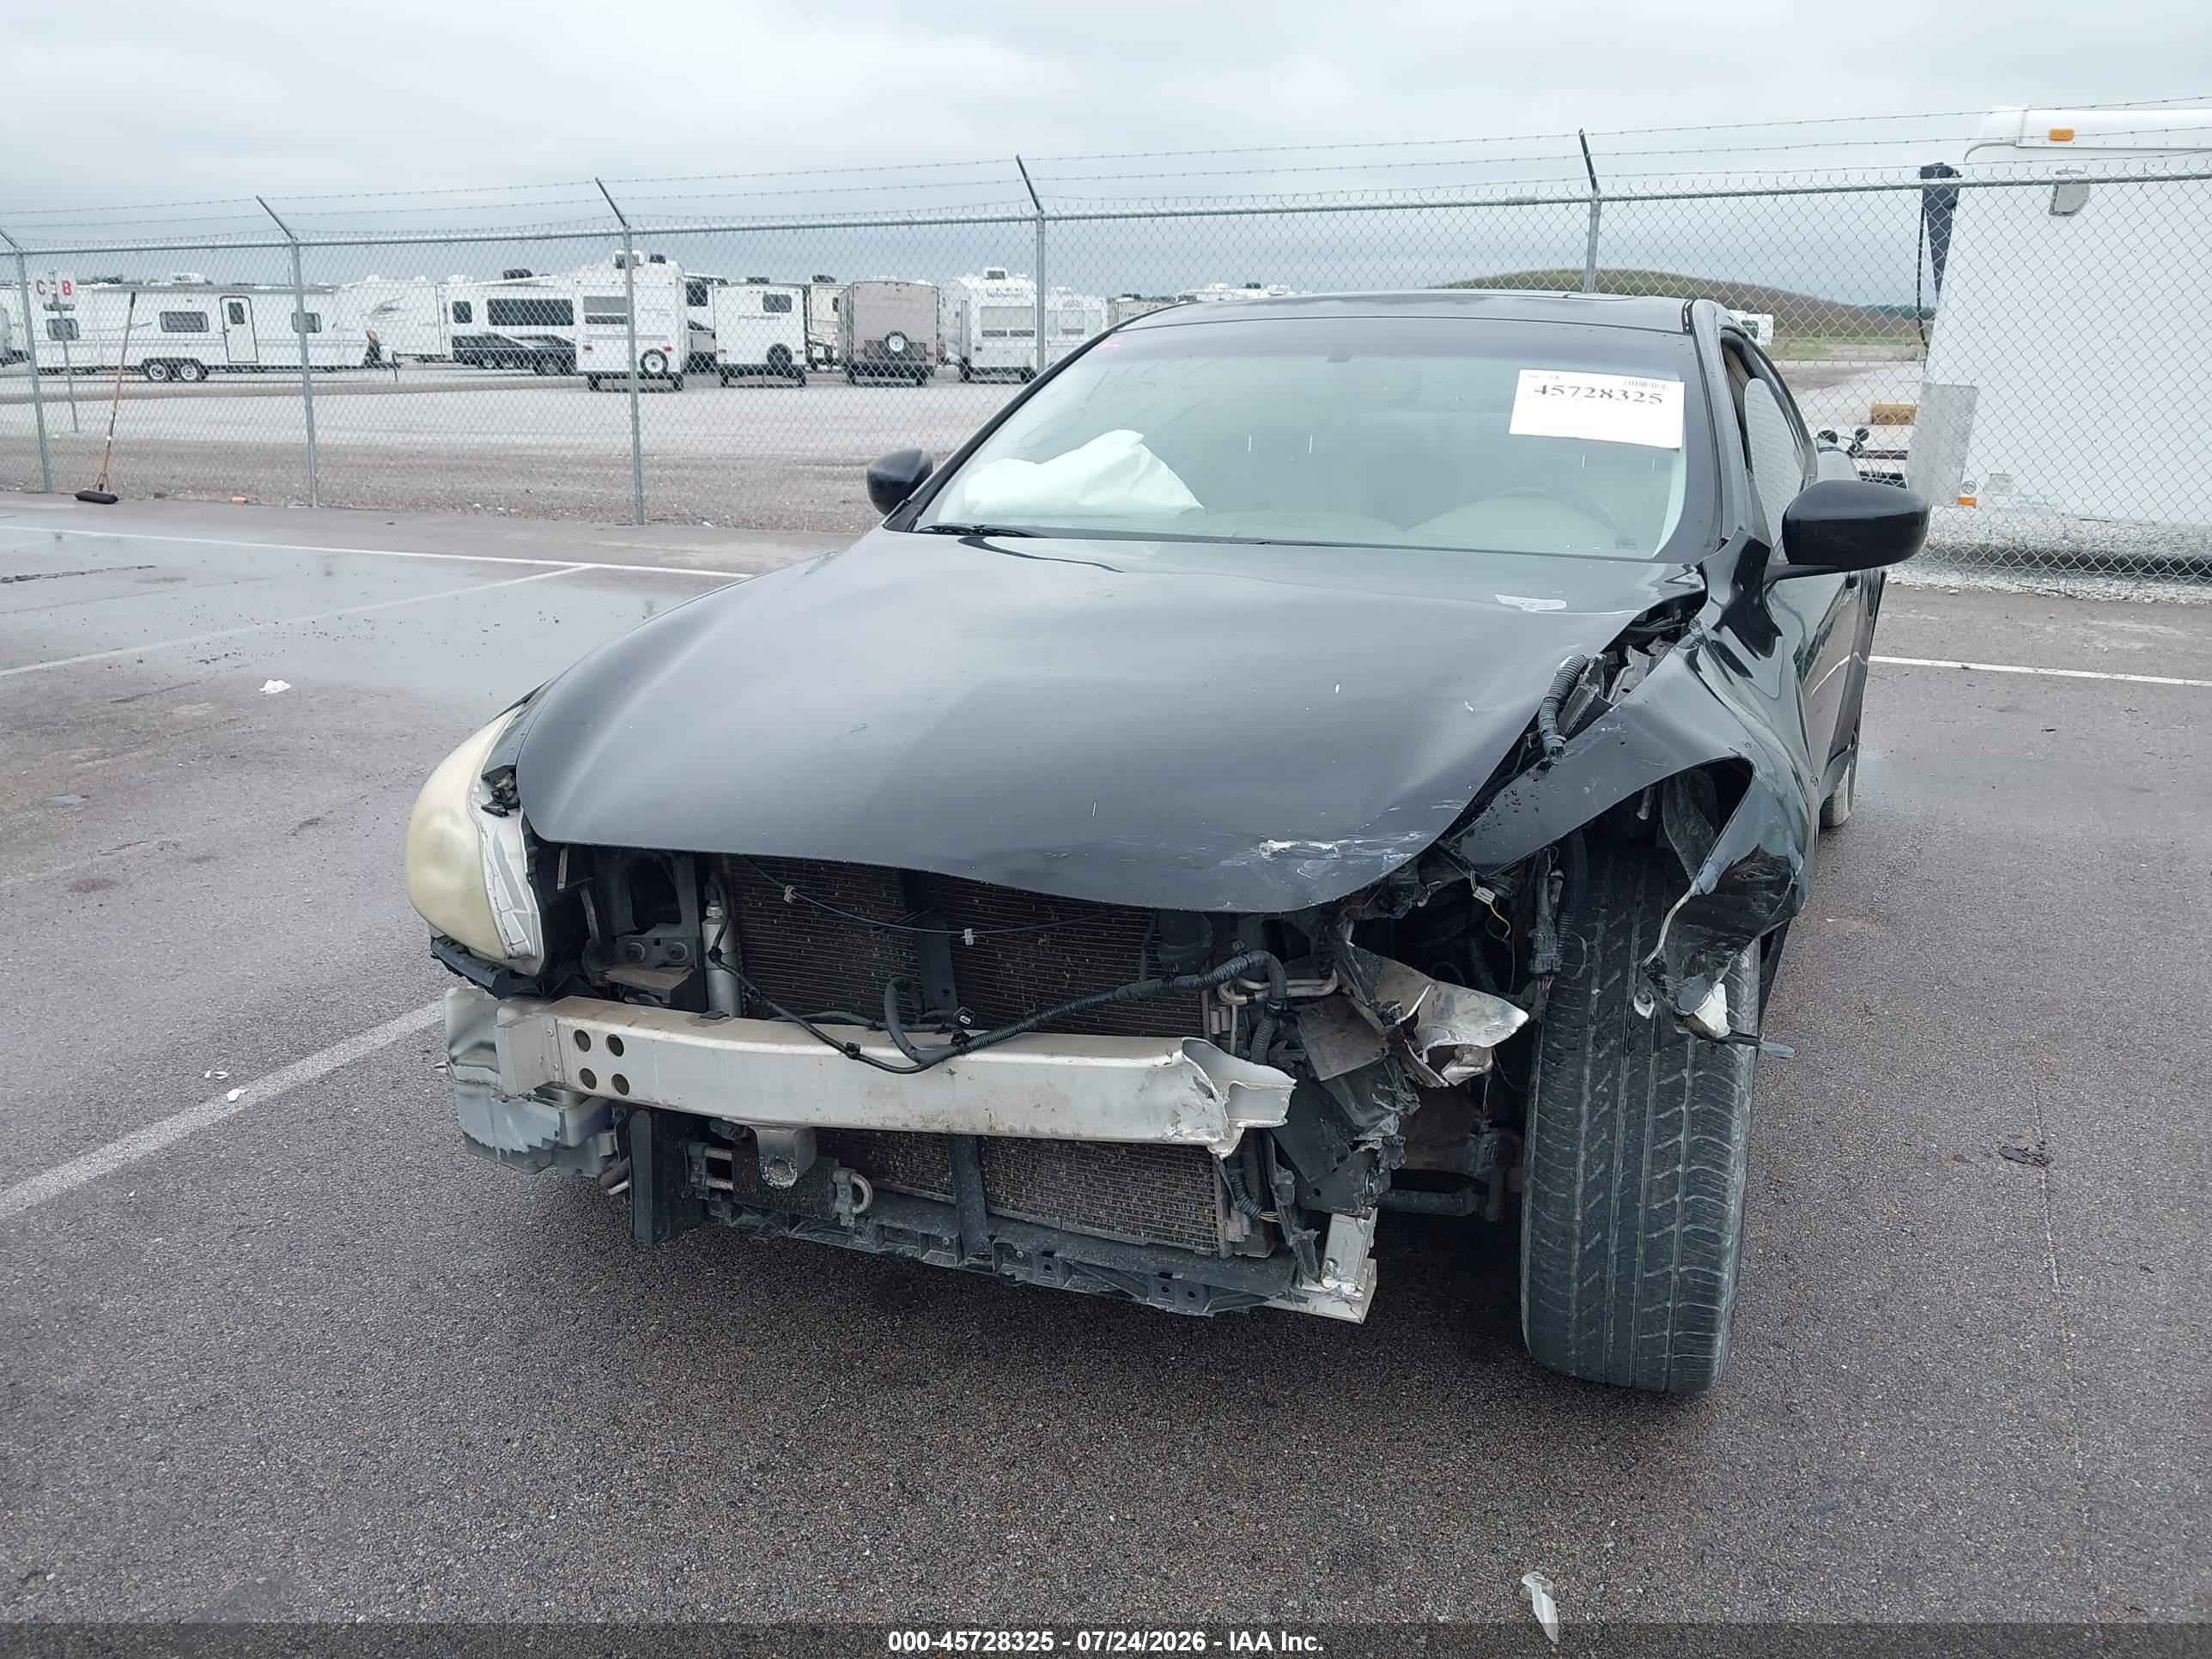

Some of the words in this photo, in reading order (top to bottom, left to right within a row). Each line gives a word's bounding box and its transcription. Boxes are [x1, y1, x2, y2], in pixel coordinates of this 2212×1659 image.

[36, 279, 46, 295] C
[62, 280, 72, 295] B
[1534, 385, 1663, 404] 45728325
